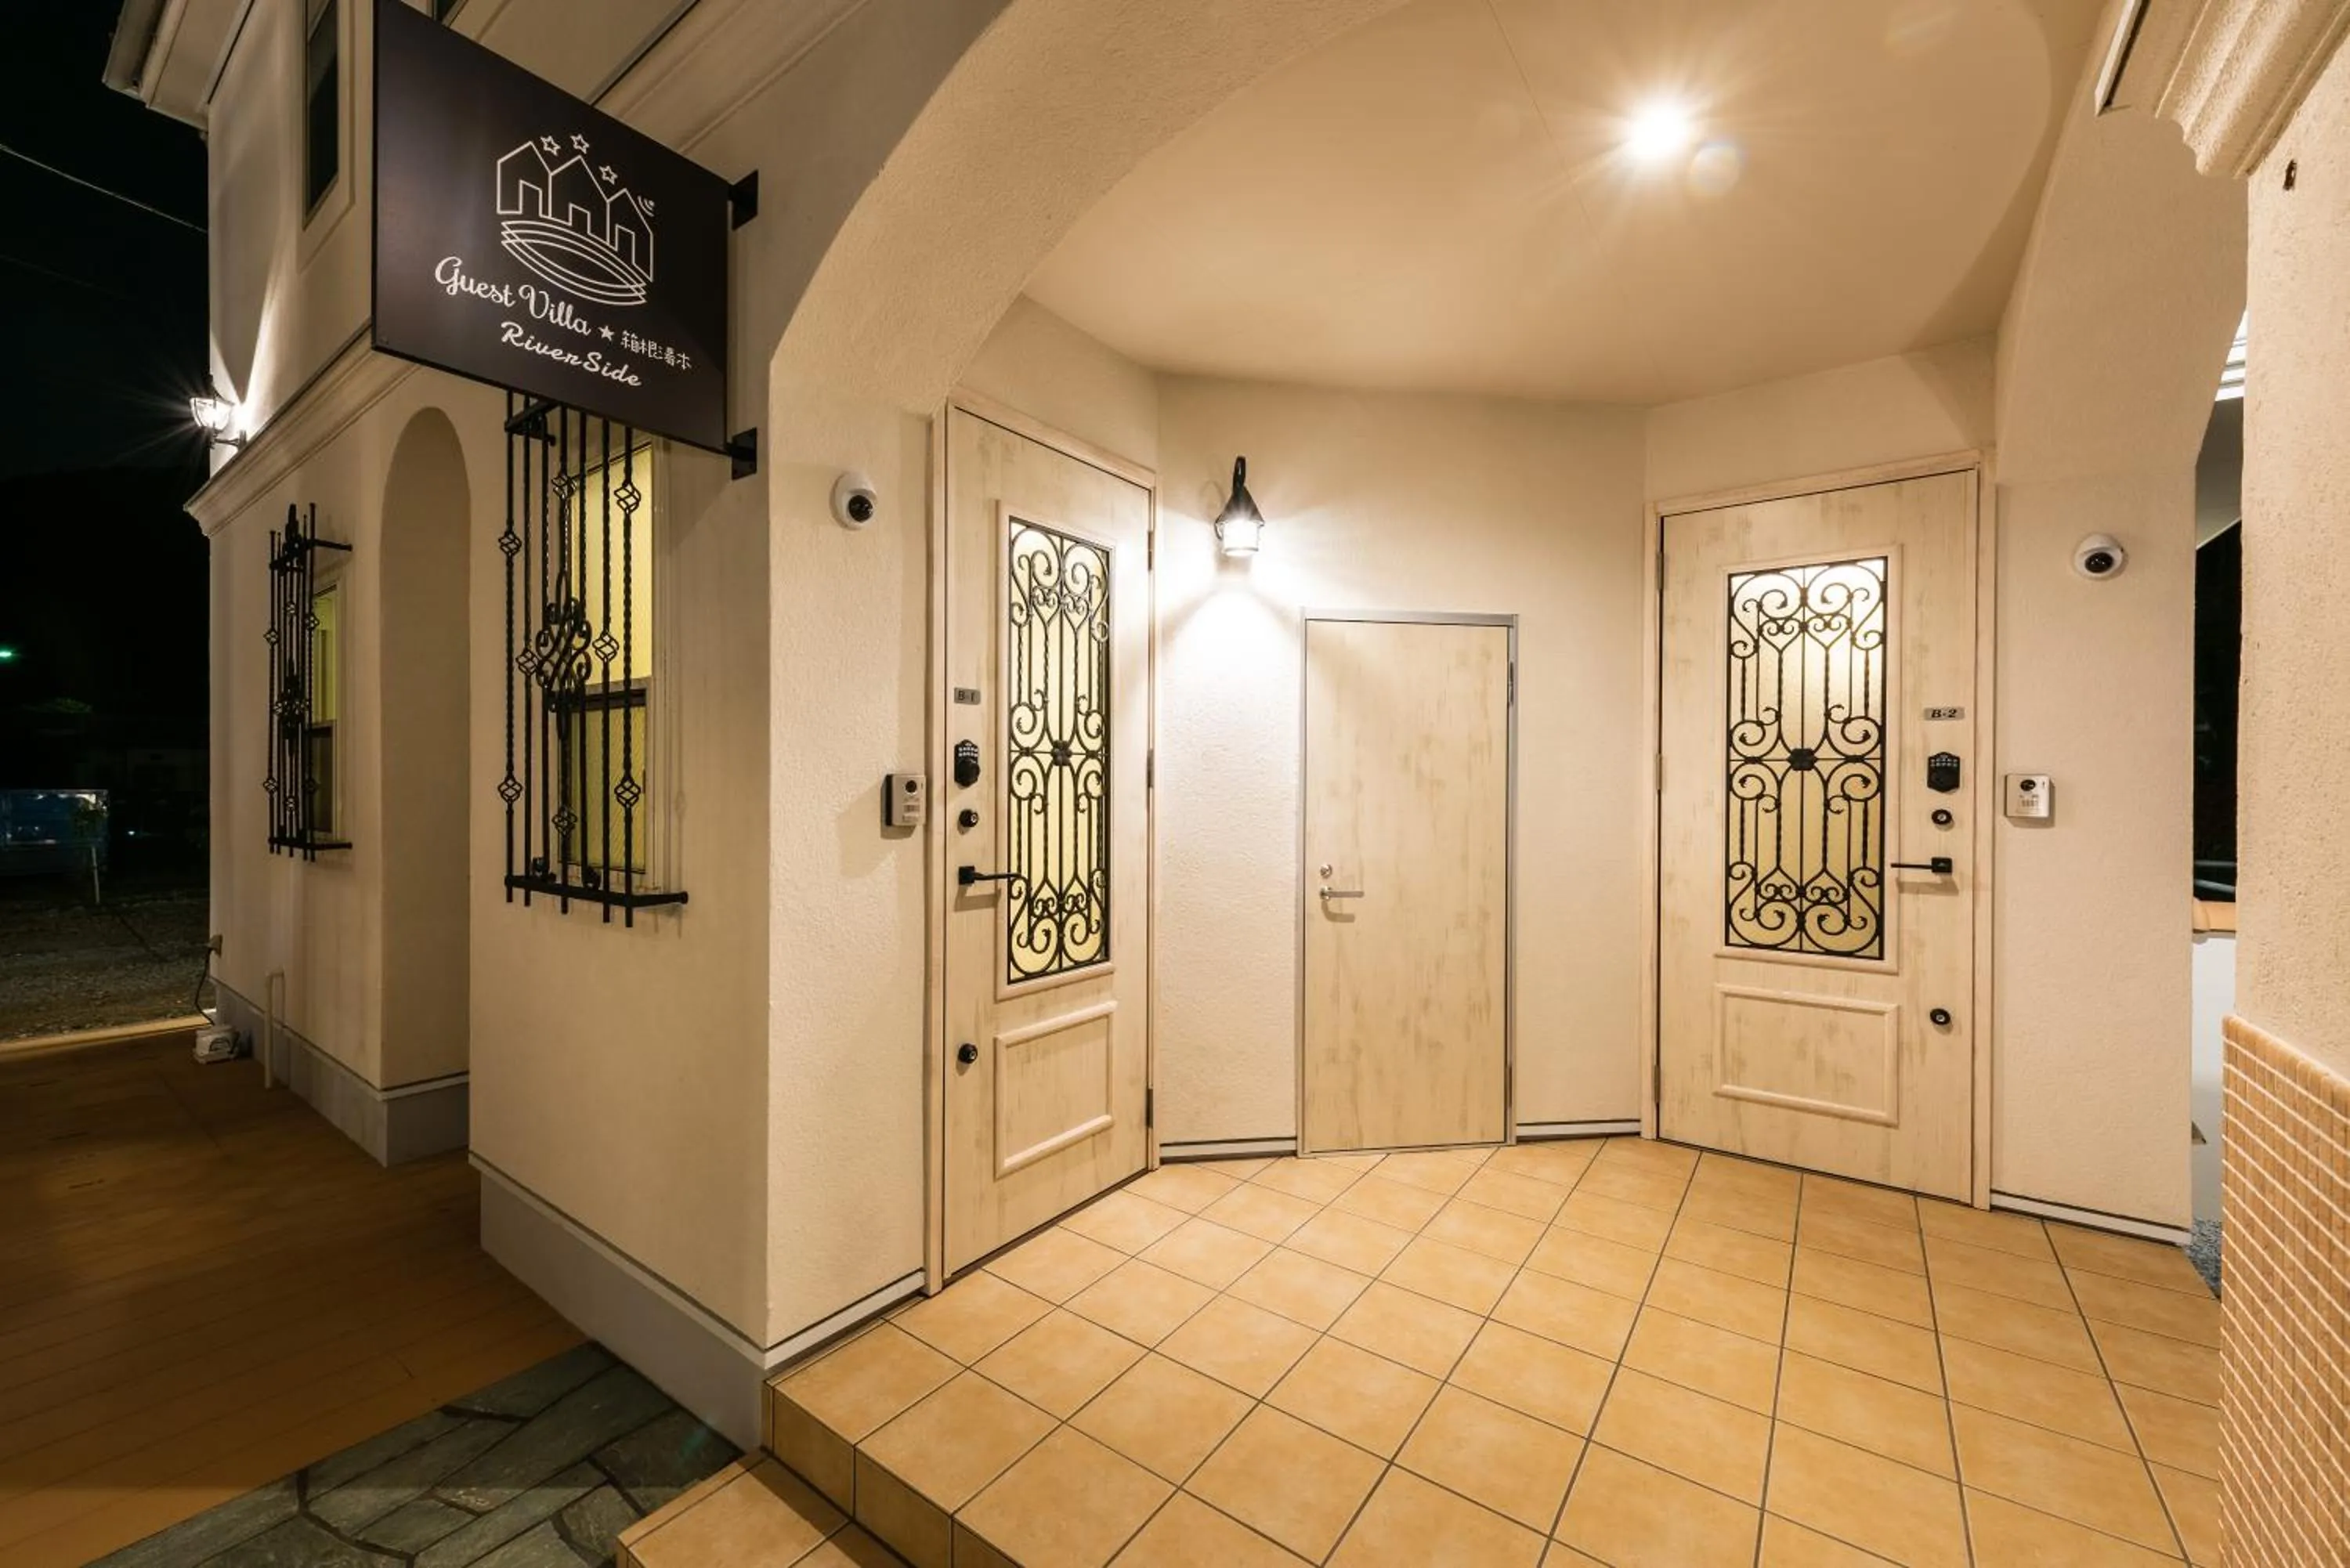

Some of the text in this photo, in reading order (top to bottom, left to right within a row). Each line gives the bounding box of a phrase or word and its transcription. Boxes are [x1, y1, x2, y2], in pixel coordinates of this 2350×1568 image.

[435, 256, 516, 307] Guest
[519, 284, 591, 336] Villa
[1931, 708, 1958, 718] B-2
